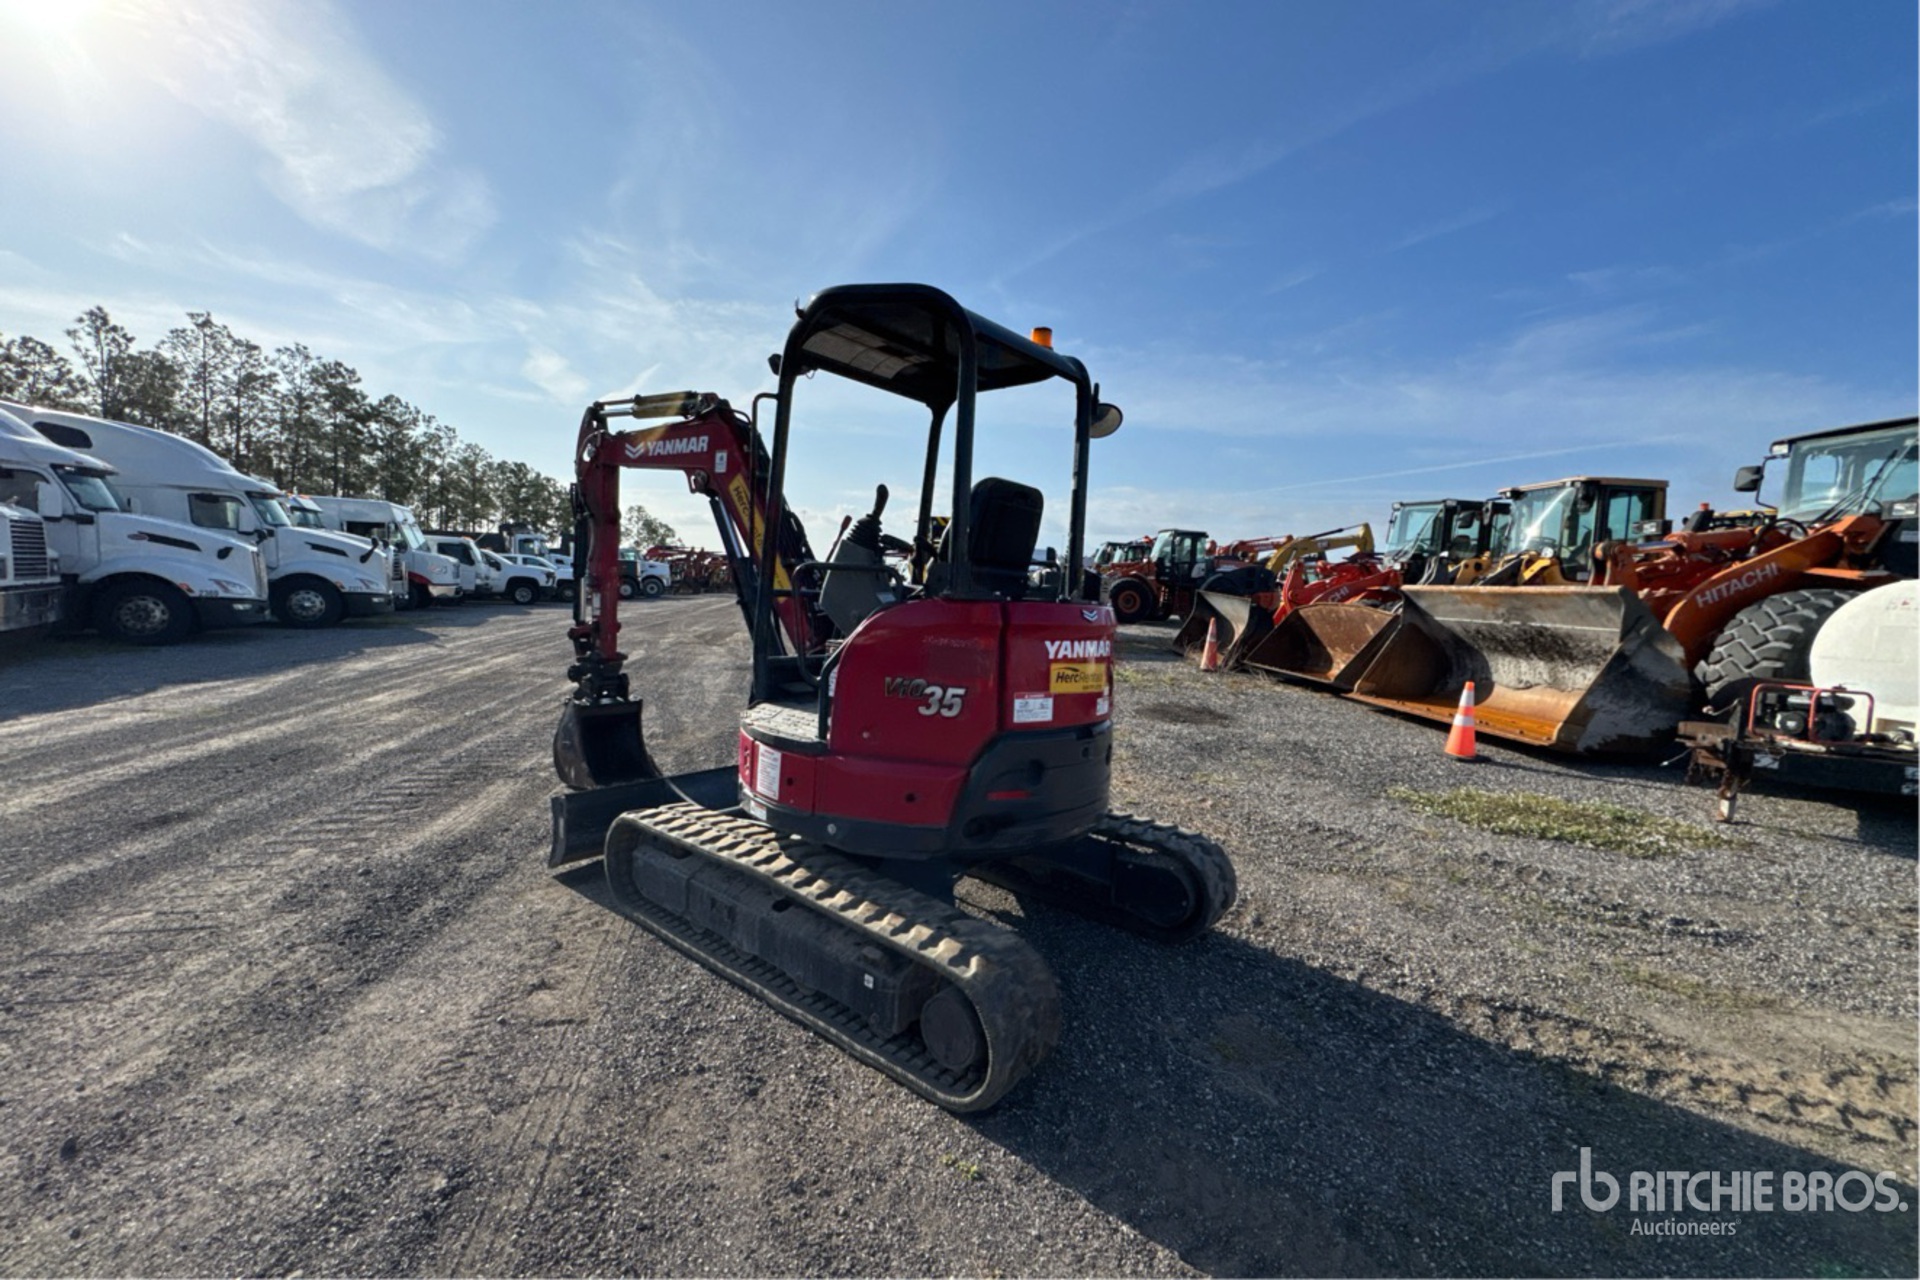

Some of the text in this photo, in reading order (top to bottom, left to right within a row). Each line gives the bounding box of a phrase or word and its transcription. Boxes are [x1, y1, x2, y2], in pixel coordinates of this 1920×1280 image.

[647, 436, 709, 456] YANMAR
[1695, 562, 1778, 608] HITACHI
[918, 685, 966, 717] 35
